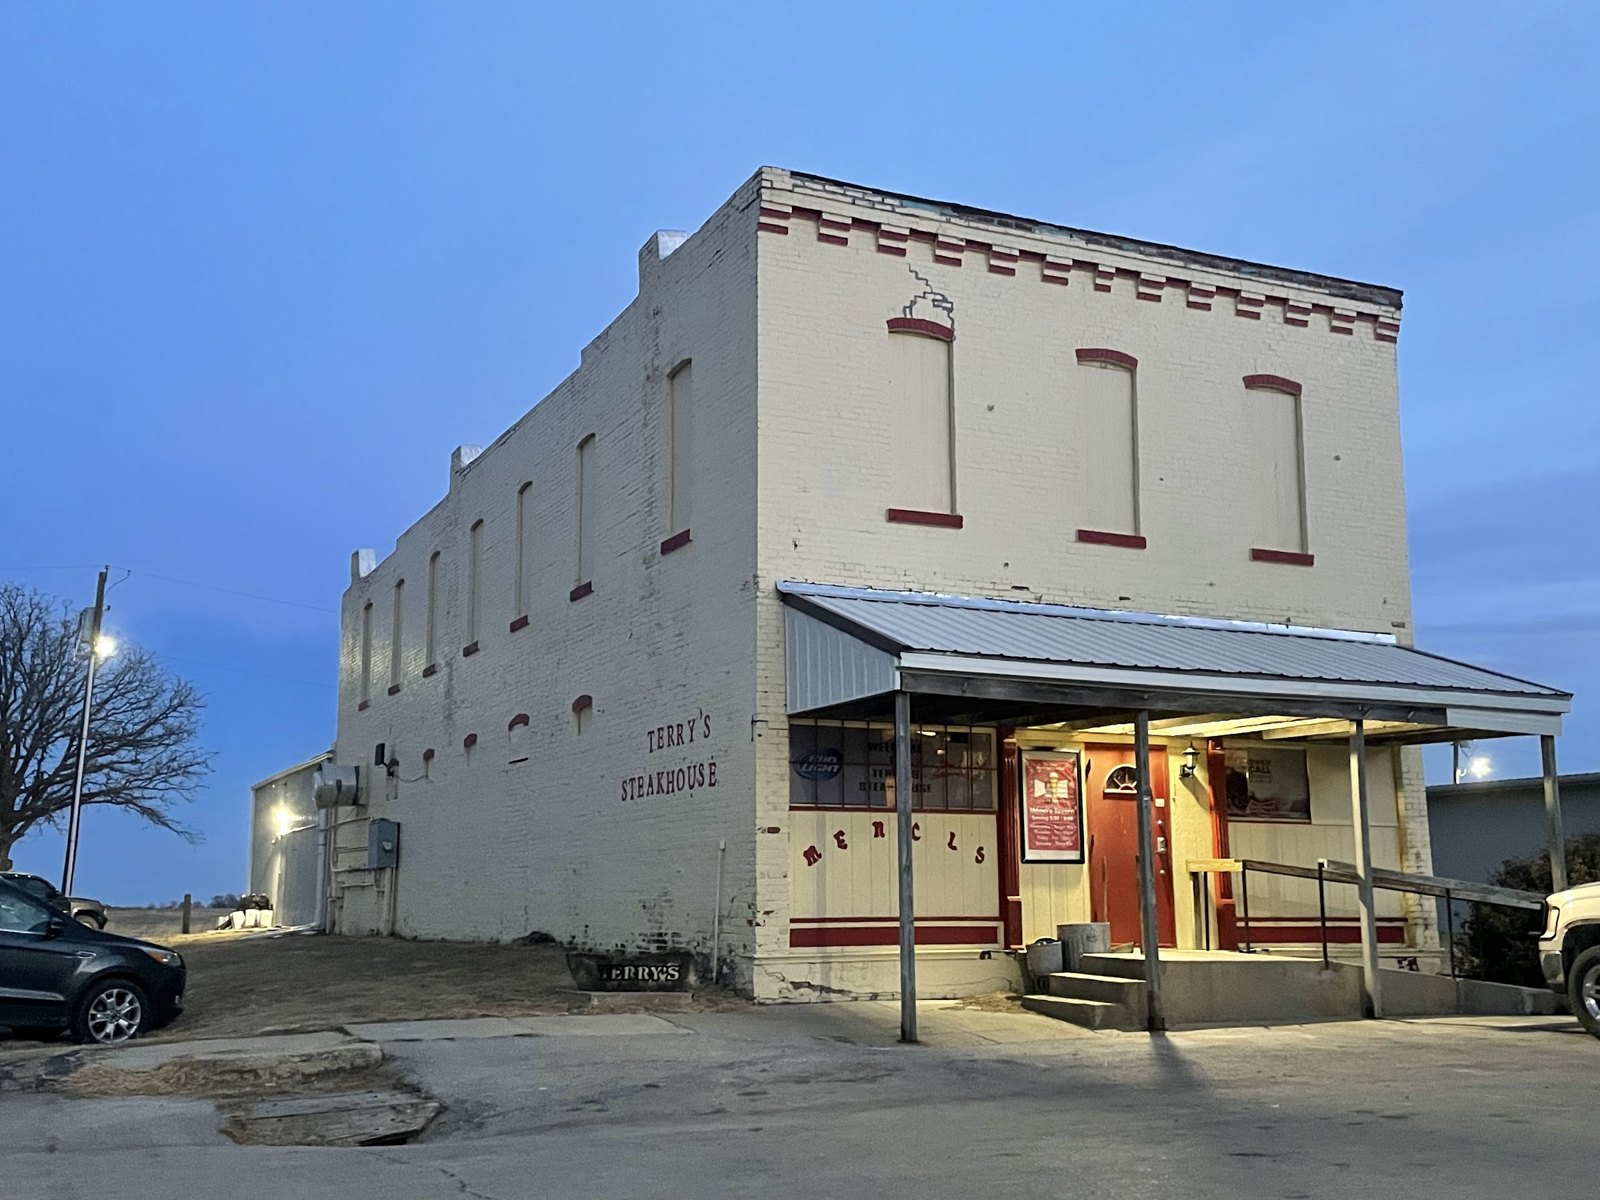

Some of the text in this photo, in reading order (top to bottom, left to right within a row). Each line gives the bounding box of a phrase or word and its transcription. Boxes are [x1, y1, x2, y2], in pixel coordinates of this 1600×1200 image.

[647, 707, 711, 753] TERRY'S
[621, 762, 717, 801] STEAKHOUSE
[801, 763, 840, 773] LIGHT
